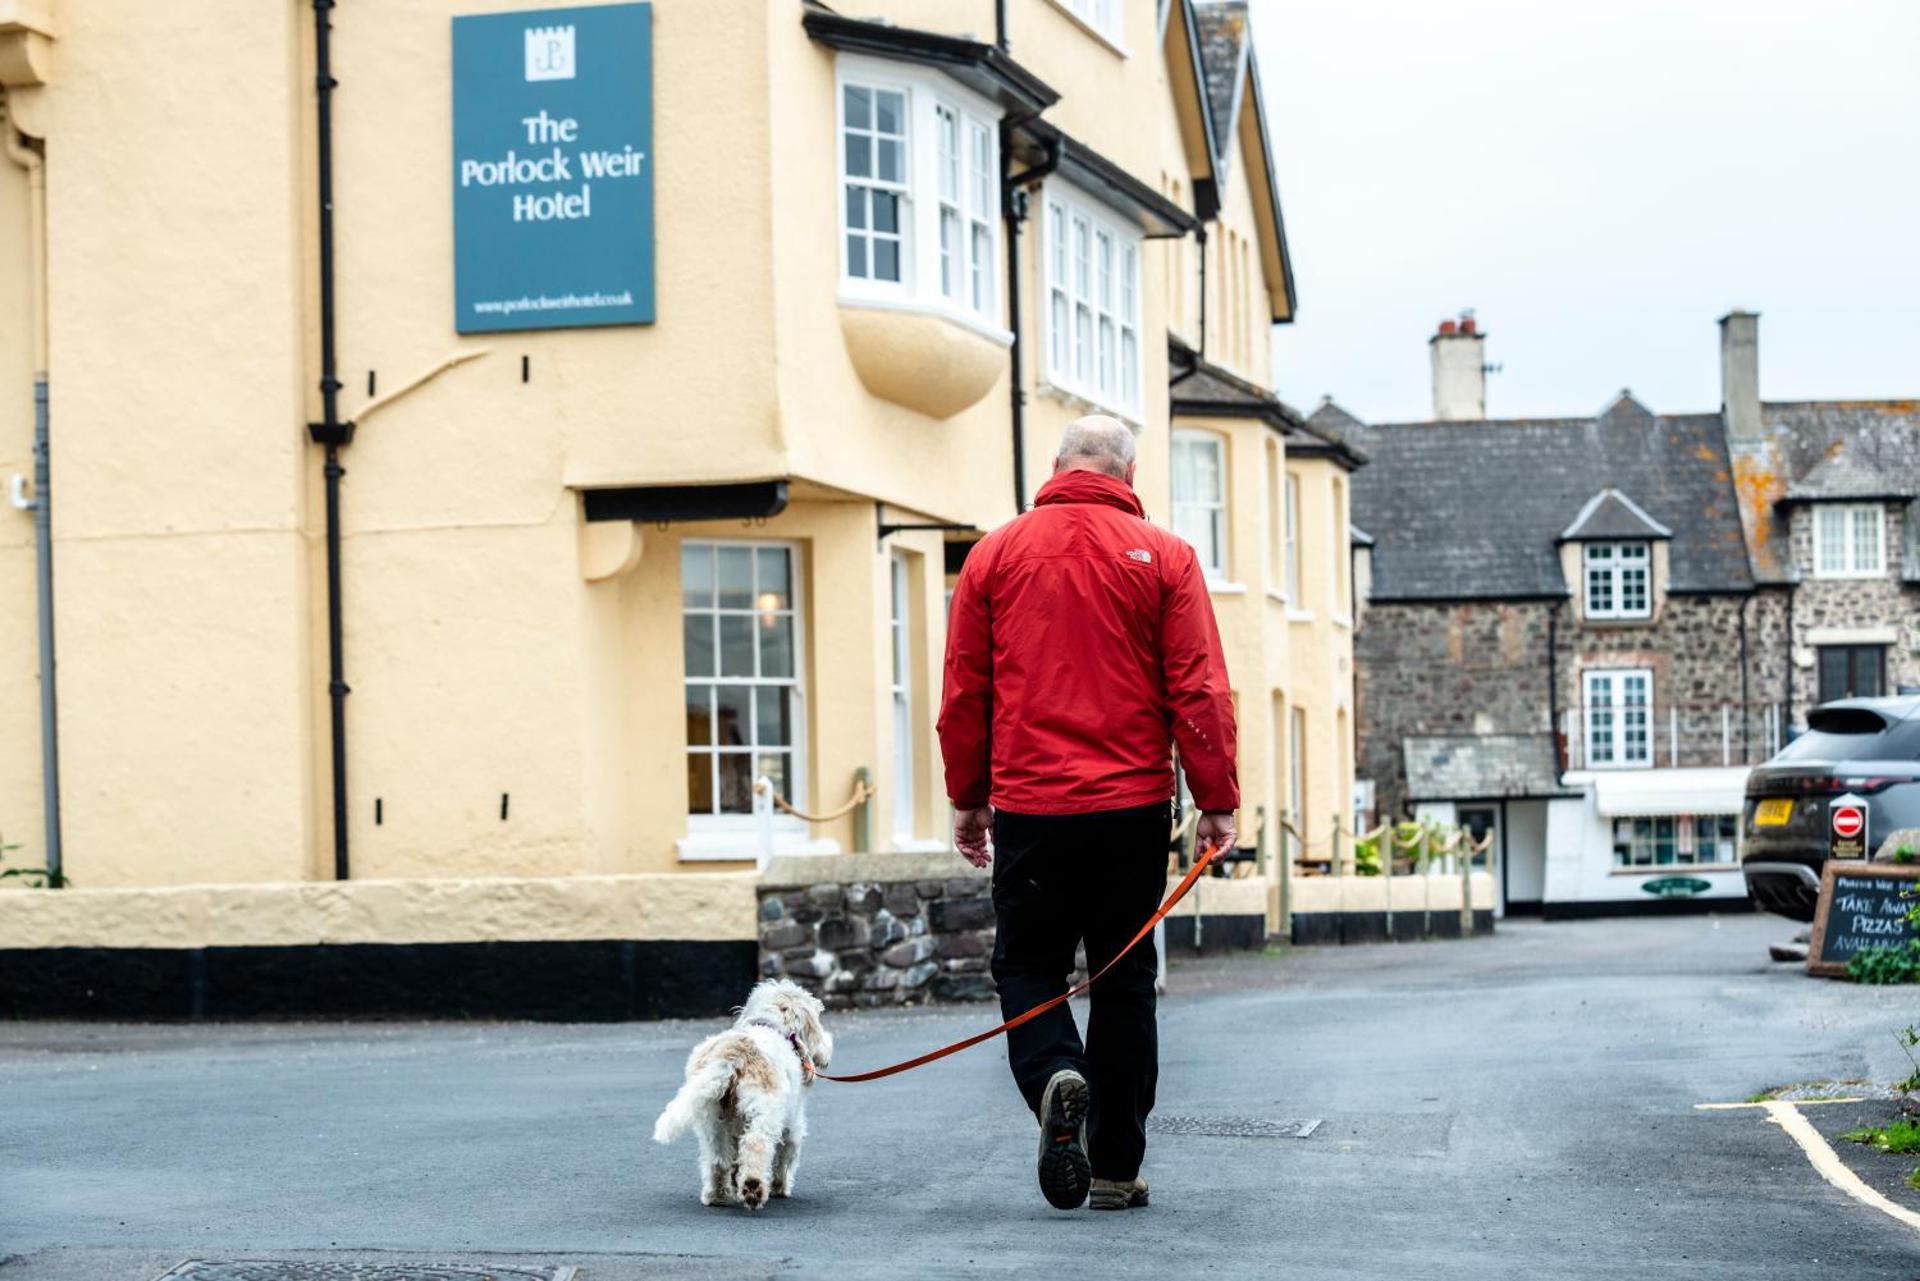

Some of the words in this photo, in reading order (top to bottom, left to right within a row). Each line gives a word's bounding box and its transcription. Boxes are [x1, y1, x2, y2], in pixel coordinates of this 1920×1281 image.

[522, 109, 578, 144] The
[461, 147, 572, 187] Porlock
[579, 144, 645, 179] Weir
[513, 183, 591, 222] Hotel
[1880, 897, 1917, 914] AWAY
[1852, 915, 1904, 934] PIZZAS
